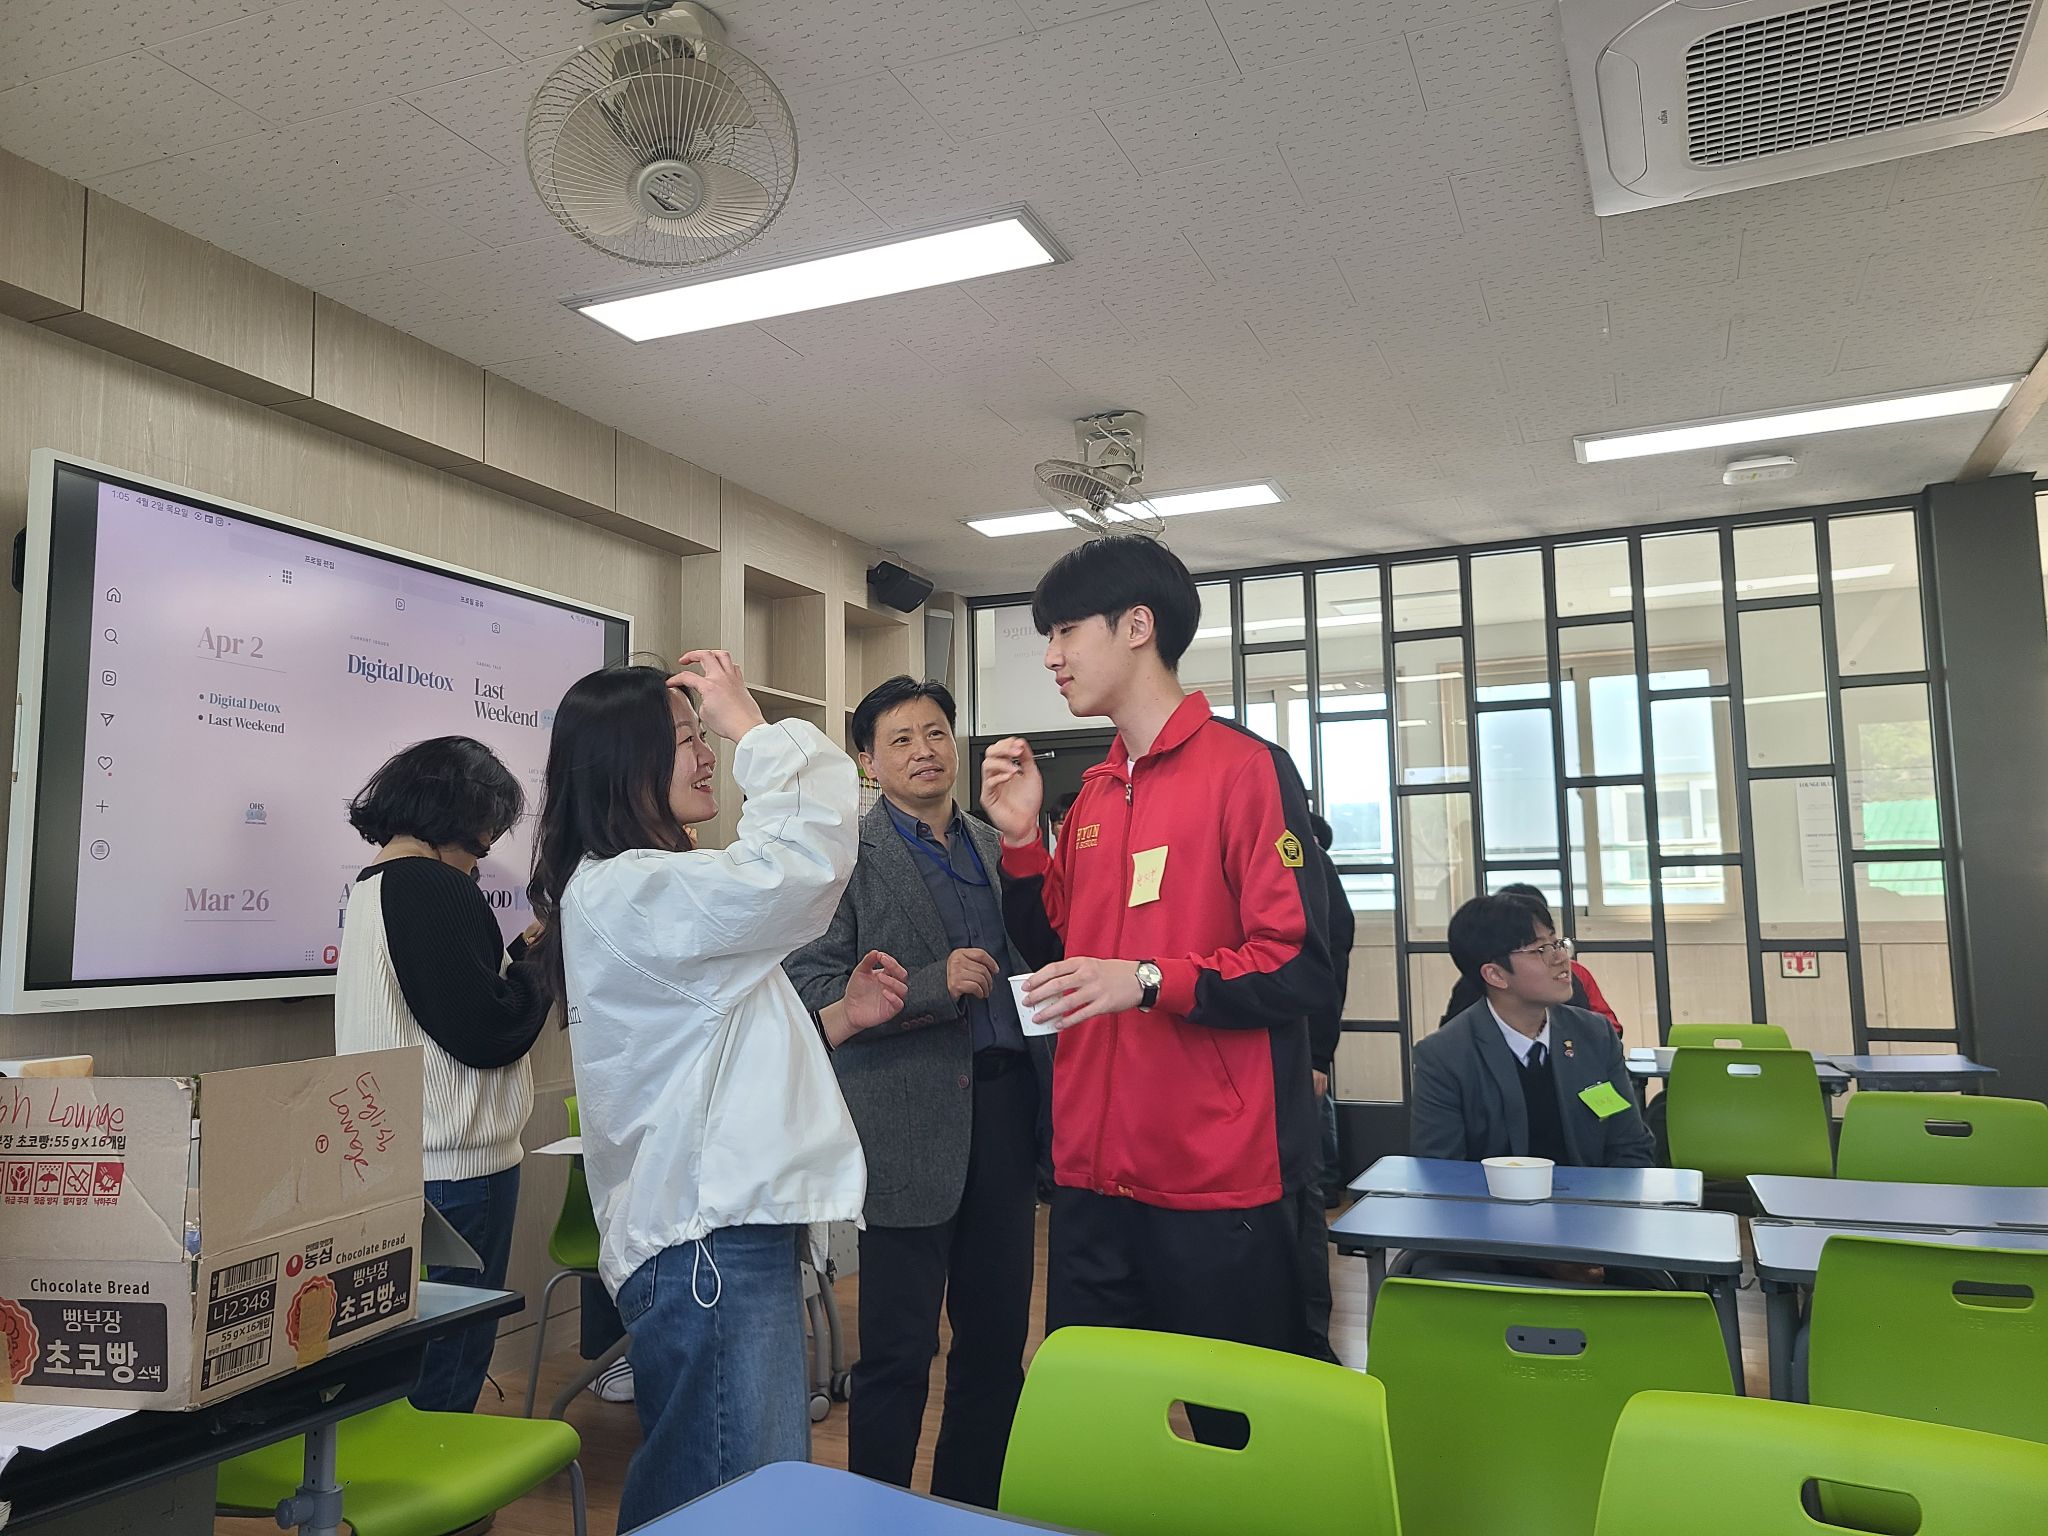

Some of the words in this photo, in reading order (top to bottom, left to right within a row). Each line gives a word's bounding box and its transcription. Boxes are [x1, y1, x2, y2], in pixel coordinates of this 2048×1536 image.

[112, 490, 130, 502] 1:05
[136, 497, 149, 507] 4월
[151, 500, 164, 512] 2일
[166, 504, 189, 518] 목요일
[197, 626, 244, 658] Apr
[250, 636, 264, 659] 2
[348, 654, 403, 684] Digital
[407, 665, 454, 692] Detox
[209, 692, 247, 709] Digital
[249, 698, 281, 714] Detox
[474, 678, 505, 701] Last
[208, 713, 233, 728] Last
[235, 716, 285, 734] Weekend
[474, 701, 538, 728] Weekend
[249, 802, 265, 811] OHS
[184, 887, 236, 912] Mar
[241, 888, 270, 912] 26
[48, 1085, 125, 1139] Lounge
[305, 1246, 333, 1269] 농심
[336, 1243, 380, 1265] Chocolate
[382, 1234, 405, 1251] Bread
[31, 1278, 102, 1294] Chocolate
[108, 1281, 150, 1295] Bread
[354, 1260, 388, 1288] 빵부장
[213, 1290, 270, 1324] 나2348
[336, 1280, 395, 1327] 초코빵
[393, 1292, 407, 1307] 스낵
[63, 1308, 122, 1334] 빵부장
[44, 1339, 139, 1384] 초코빵
[137, 1365, 161, 1383] 스낵
